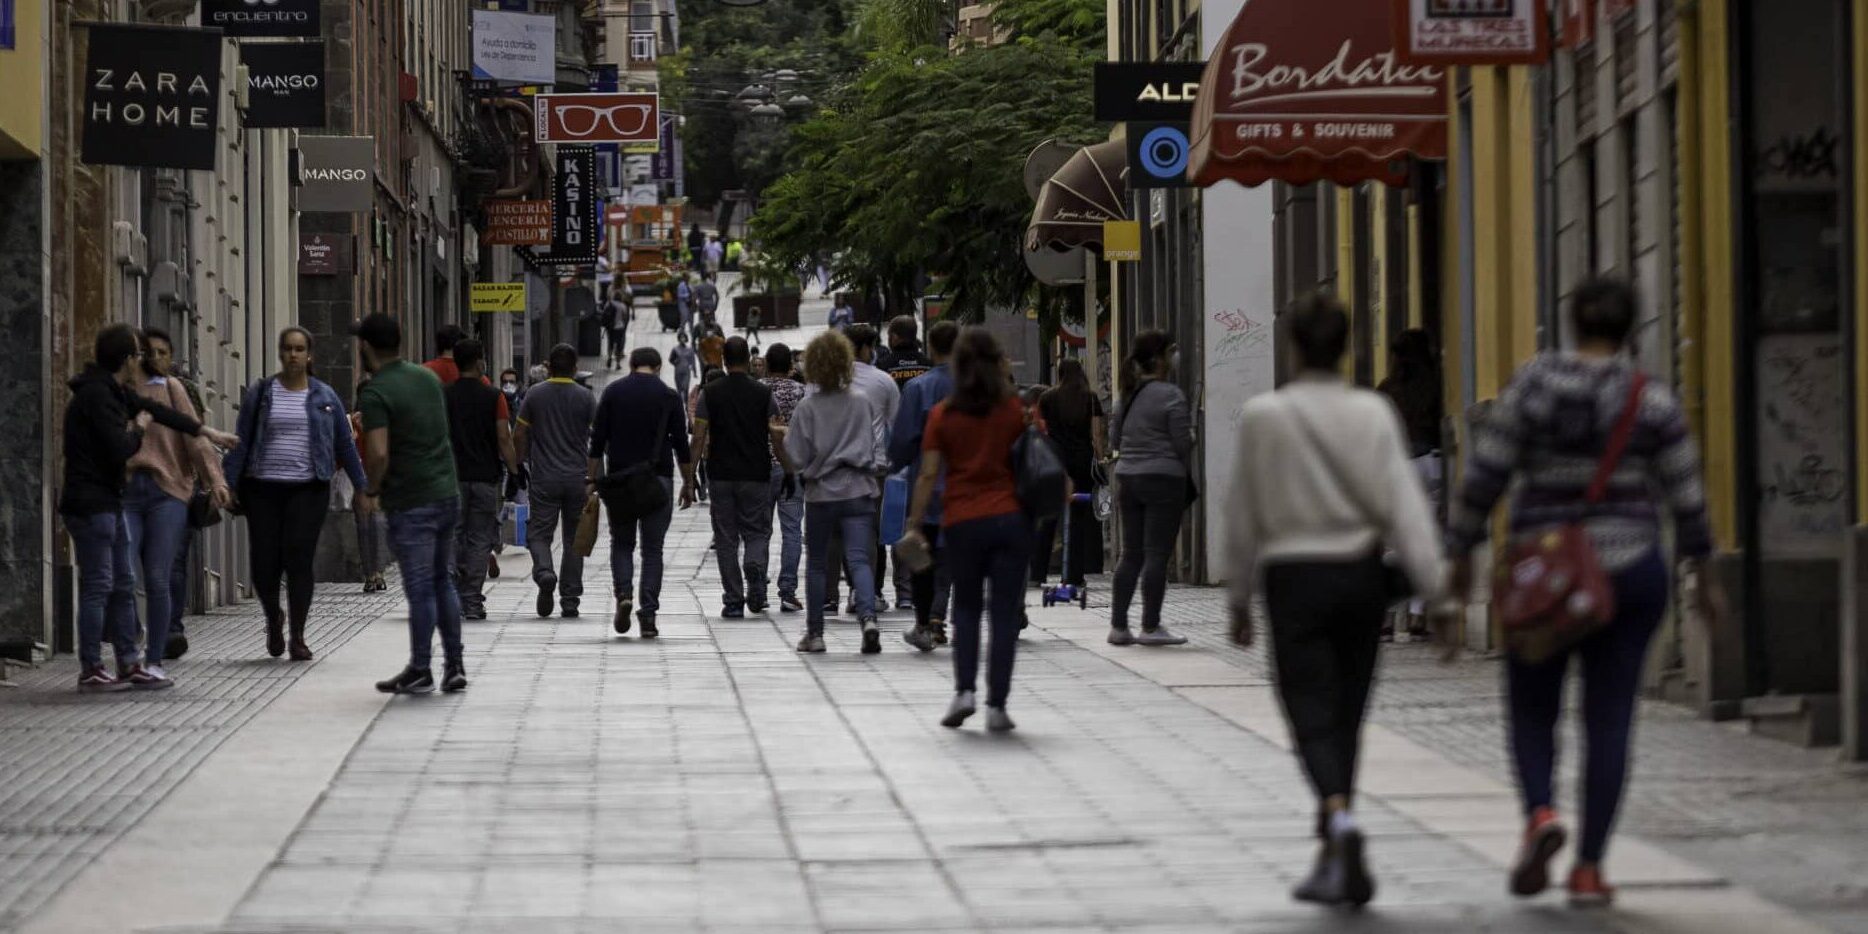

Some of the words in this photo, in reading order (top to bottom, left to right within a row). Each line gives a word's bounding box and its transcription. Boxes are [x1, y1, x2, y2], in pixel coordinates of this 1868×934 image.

[213, 10, 308, 21] encuentro
[95, 68, 210, 95] ZARA
[247, 74, 318, 89] MANGO
[92, 101, 209, 127] HOME
[1236, 123, 1282, 137] GIFTS
[1292, 123, 1304, 137] &
[1314, 122, 1395, 138] SOUVENIR
[304, 168, 367, 180] MANGO
[564, 159, 581, 244] KASINO
[496, 228, 538, 240] CASTILLO
[1106, 249, 1138, 260] orange
